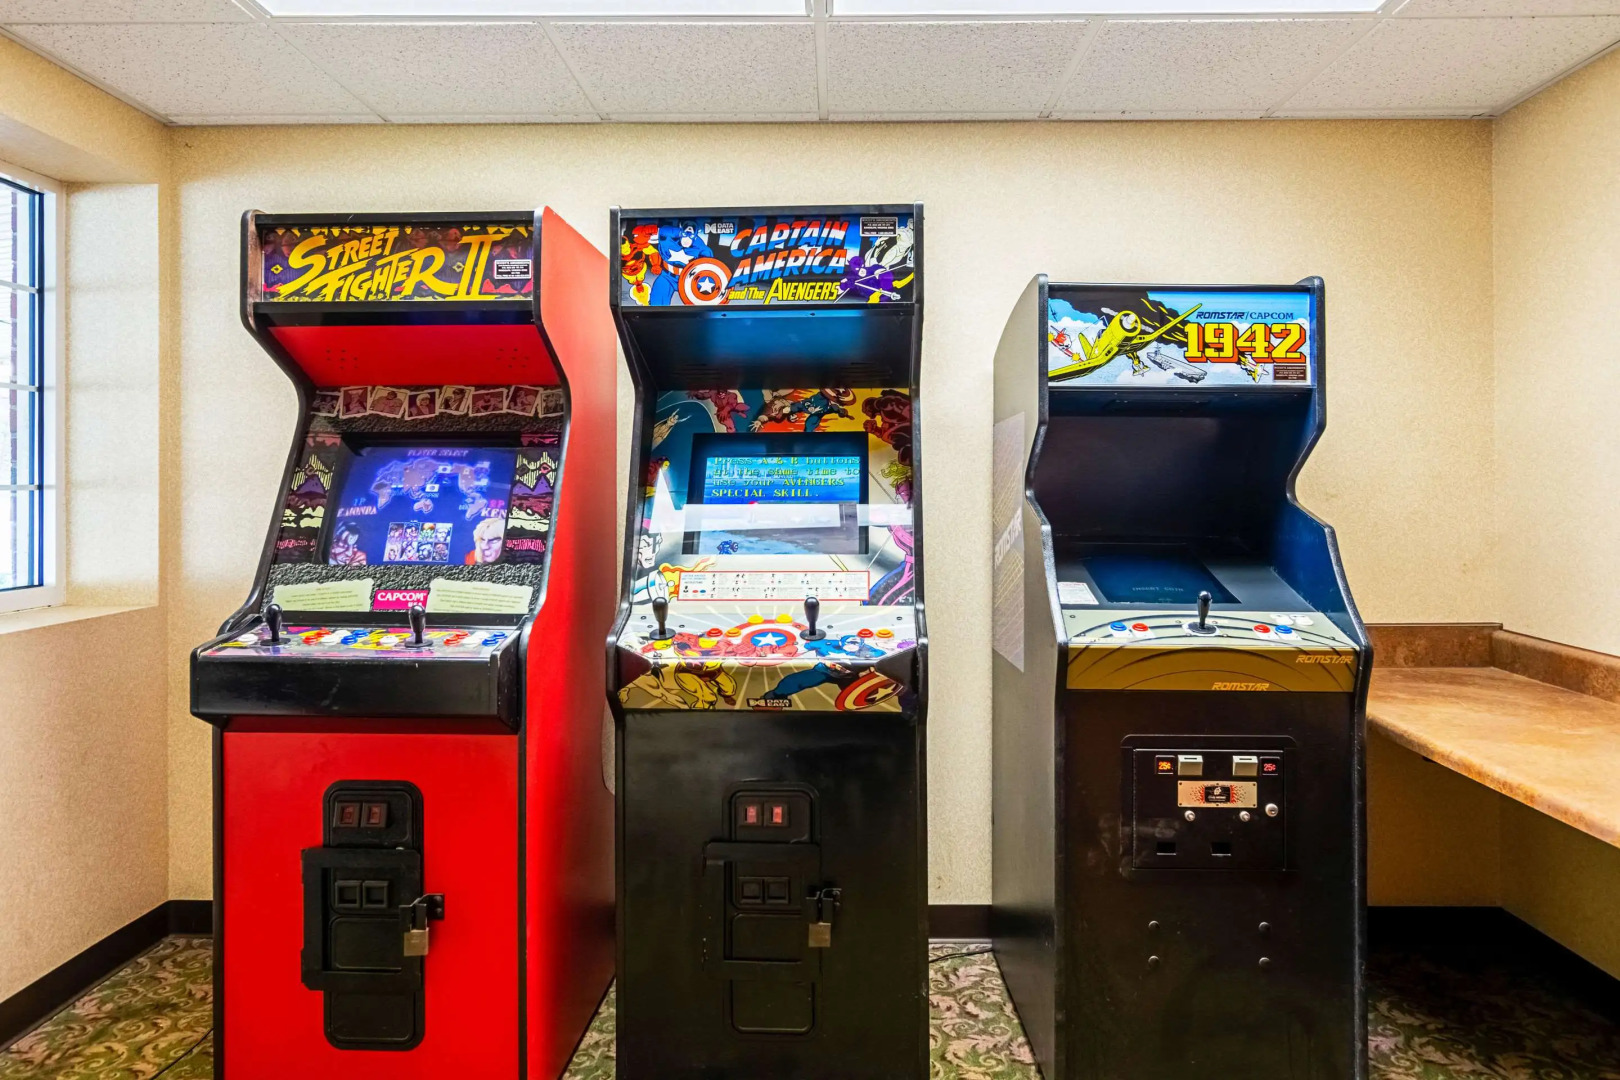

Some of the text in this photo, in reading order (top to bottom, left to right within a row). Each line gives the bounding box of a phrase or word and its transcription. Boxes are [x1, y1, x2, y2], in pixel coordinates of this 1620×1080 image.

[731, 221, 849, 257] CAPTAIN
[278, 231, 399, 298] STREET
[302, 233, 511, 301] FIGHTER II
[728, 248, 847, 287] AMERICA
[729, 277, 841, 305] and The AVENGERS
[1184, 322, 1306, 363] 1942
[714, 457, 753, 465] Press
[761, 457, 769, 465] A
[806, 457, 860, 465] buttons
[737, 467, 760, 476] the
[768, 467, 799, 476] same
[806, 467, 837, 476] time
[845, 467, 860, 476] to
[743, 479, 774, 487] your
[782, 478, 845, 486] AVENGERS
[711, 489, 766, 497] SPECIAL
[481, 507, 507, 518] KEN
[377, 592, 424, 601] CAPCOM
[1296, 654, 1354, 664] ROMSTAR
[1212, 682, 1270, 691] ROMSTAR
